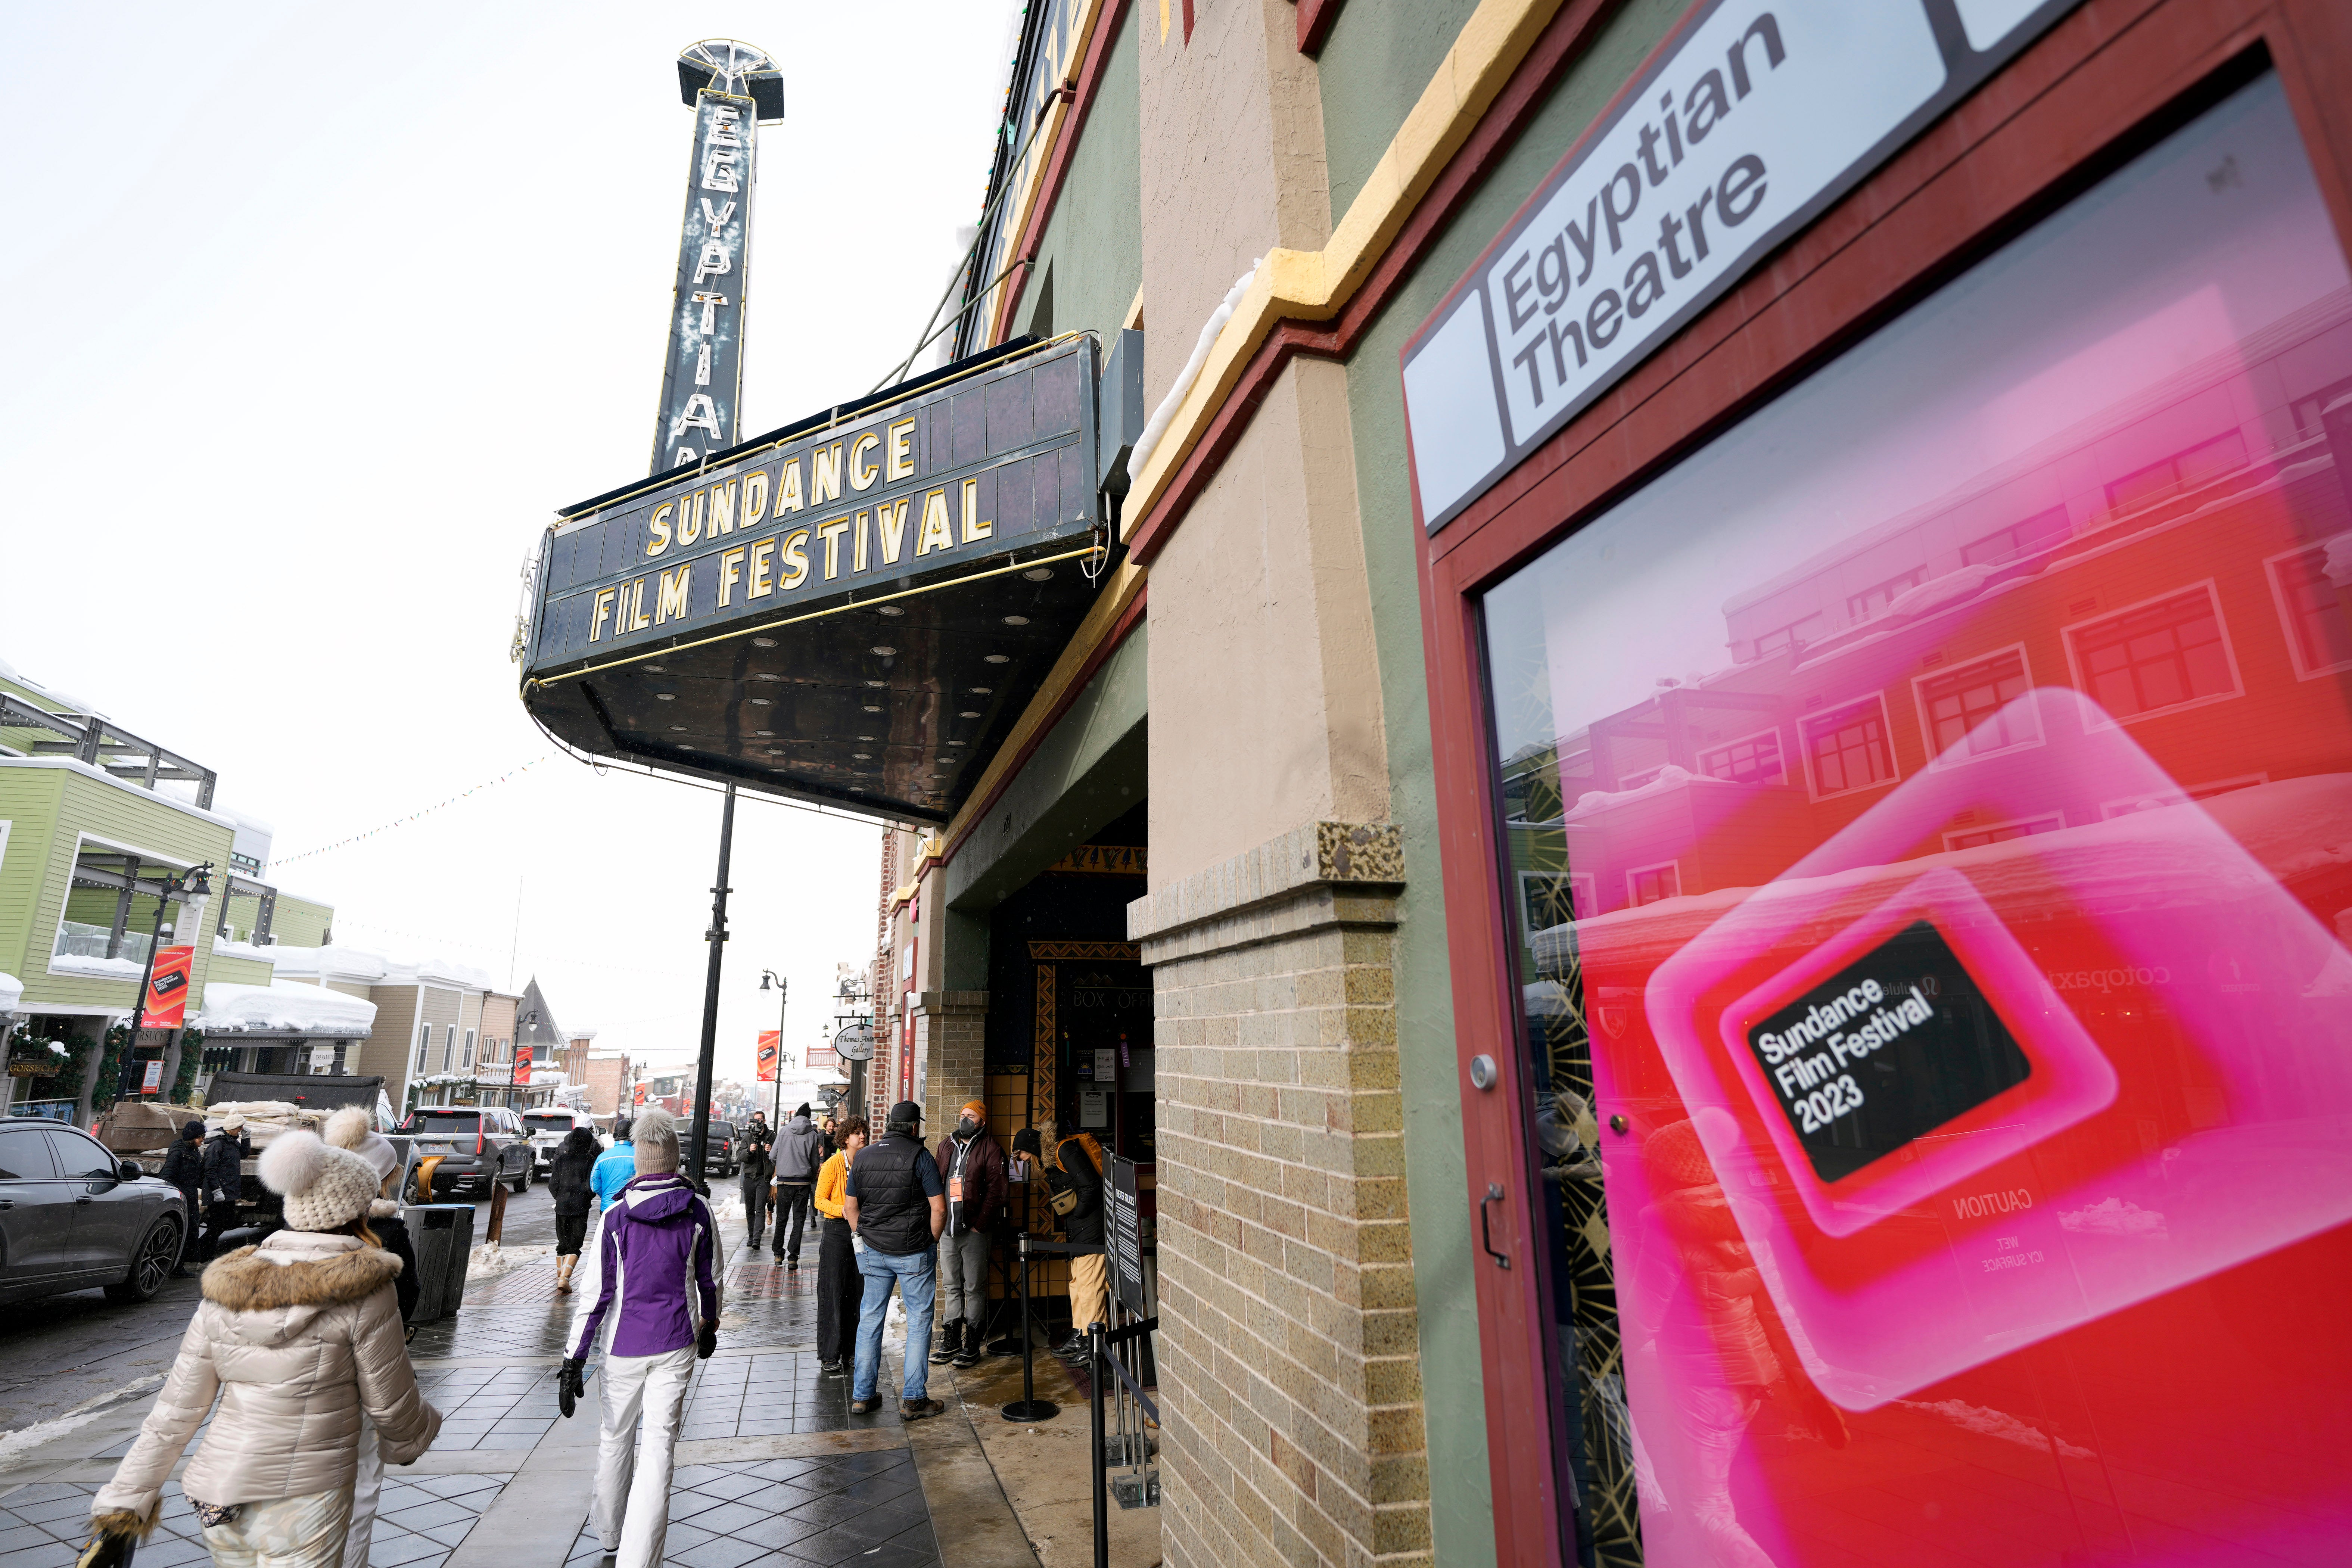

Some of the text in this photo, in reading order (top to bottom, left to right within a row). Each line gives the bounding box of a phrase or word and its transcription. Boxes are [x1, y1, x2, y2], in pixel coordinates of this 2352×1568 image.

[1503, 12, 1786, 336] Egyptian
[1513, 154, 1767, 409] Theatre
[646, 416, 916, 556] SUNDANCE
[591, 477, 992, 643] FILM FESTIVAL
[153, 974, 173, 984] Sundance
[164, 976, 178, 984] Festival
[1074, 991, 1154, 1008] BOX OFFI
[839, 1033, 859, 1043] Thomas
[1758, 979, 1883, 1064] Sundance
[851, 1043, 870, 1057] Gallery
[1774, 986, 1934, 1098] Film Festival
[9, 1064, 53, 1072] GORSUCH
[1794, 1074, 1864, 1134] 2023
[1116, 1188, 1135, 1206] THEATER POLICIES
